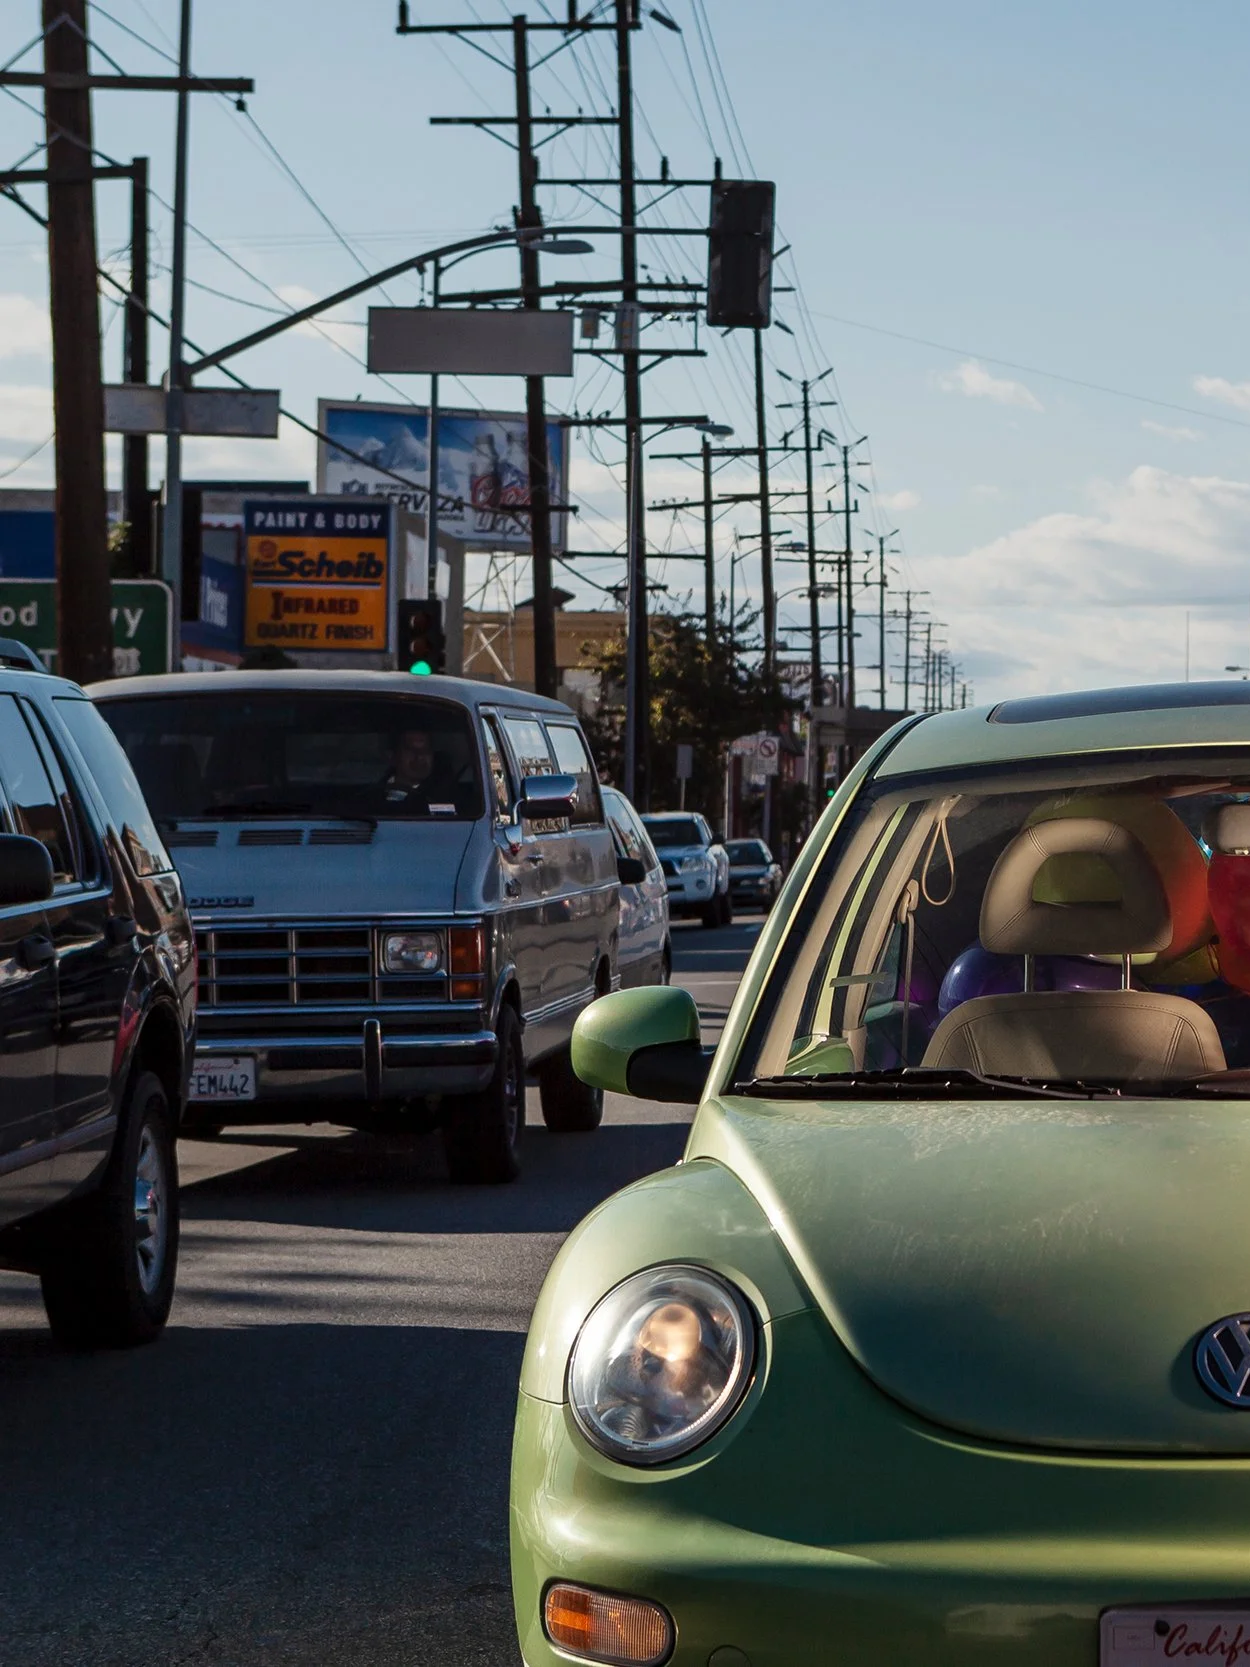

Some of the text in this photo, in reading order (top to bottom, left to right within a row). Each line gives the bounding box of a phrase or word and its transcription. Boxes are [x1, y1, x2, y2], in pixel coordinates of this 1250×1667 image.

[254, 511, 381, 529] PAINT & BODY
[278, 551, 384, 578] Scheib
[257, 623, 374, 640] QUARTZ FINISH
